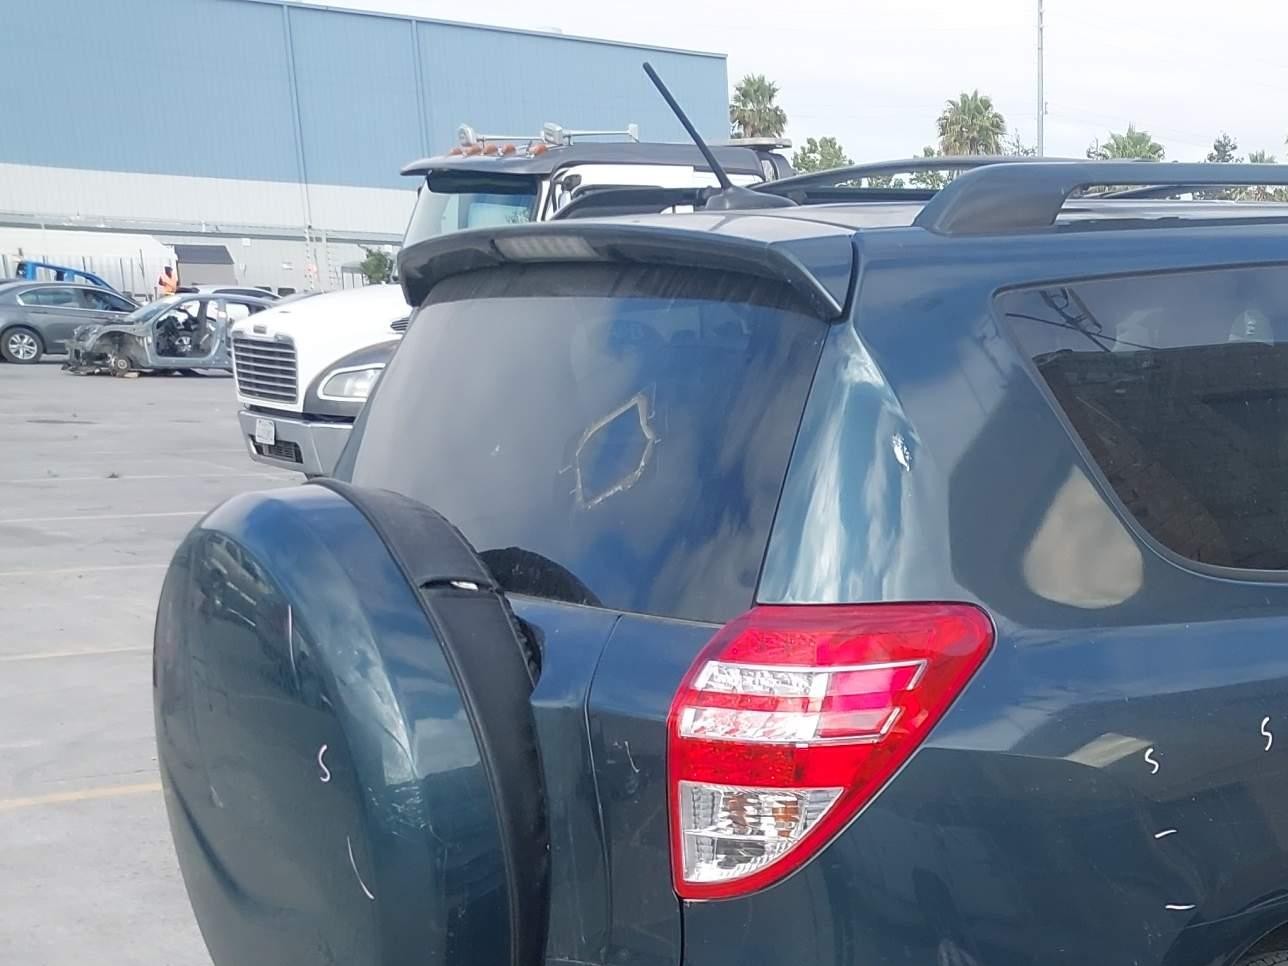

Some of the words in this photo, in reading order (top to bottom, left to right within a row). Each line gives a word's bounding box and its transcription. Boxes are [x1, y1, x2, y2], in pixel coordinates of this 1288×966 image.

[1261, 716, 1273, 751] S
[318, 744, 331, 782] S
[1144, 748, 1159, 774] S
